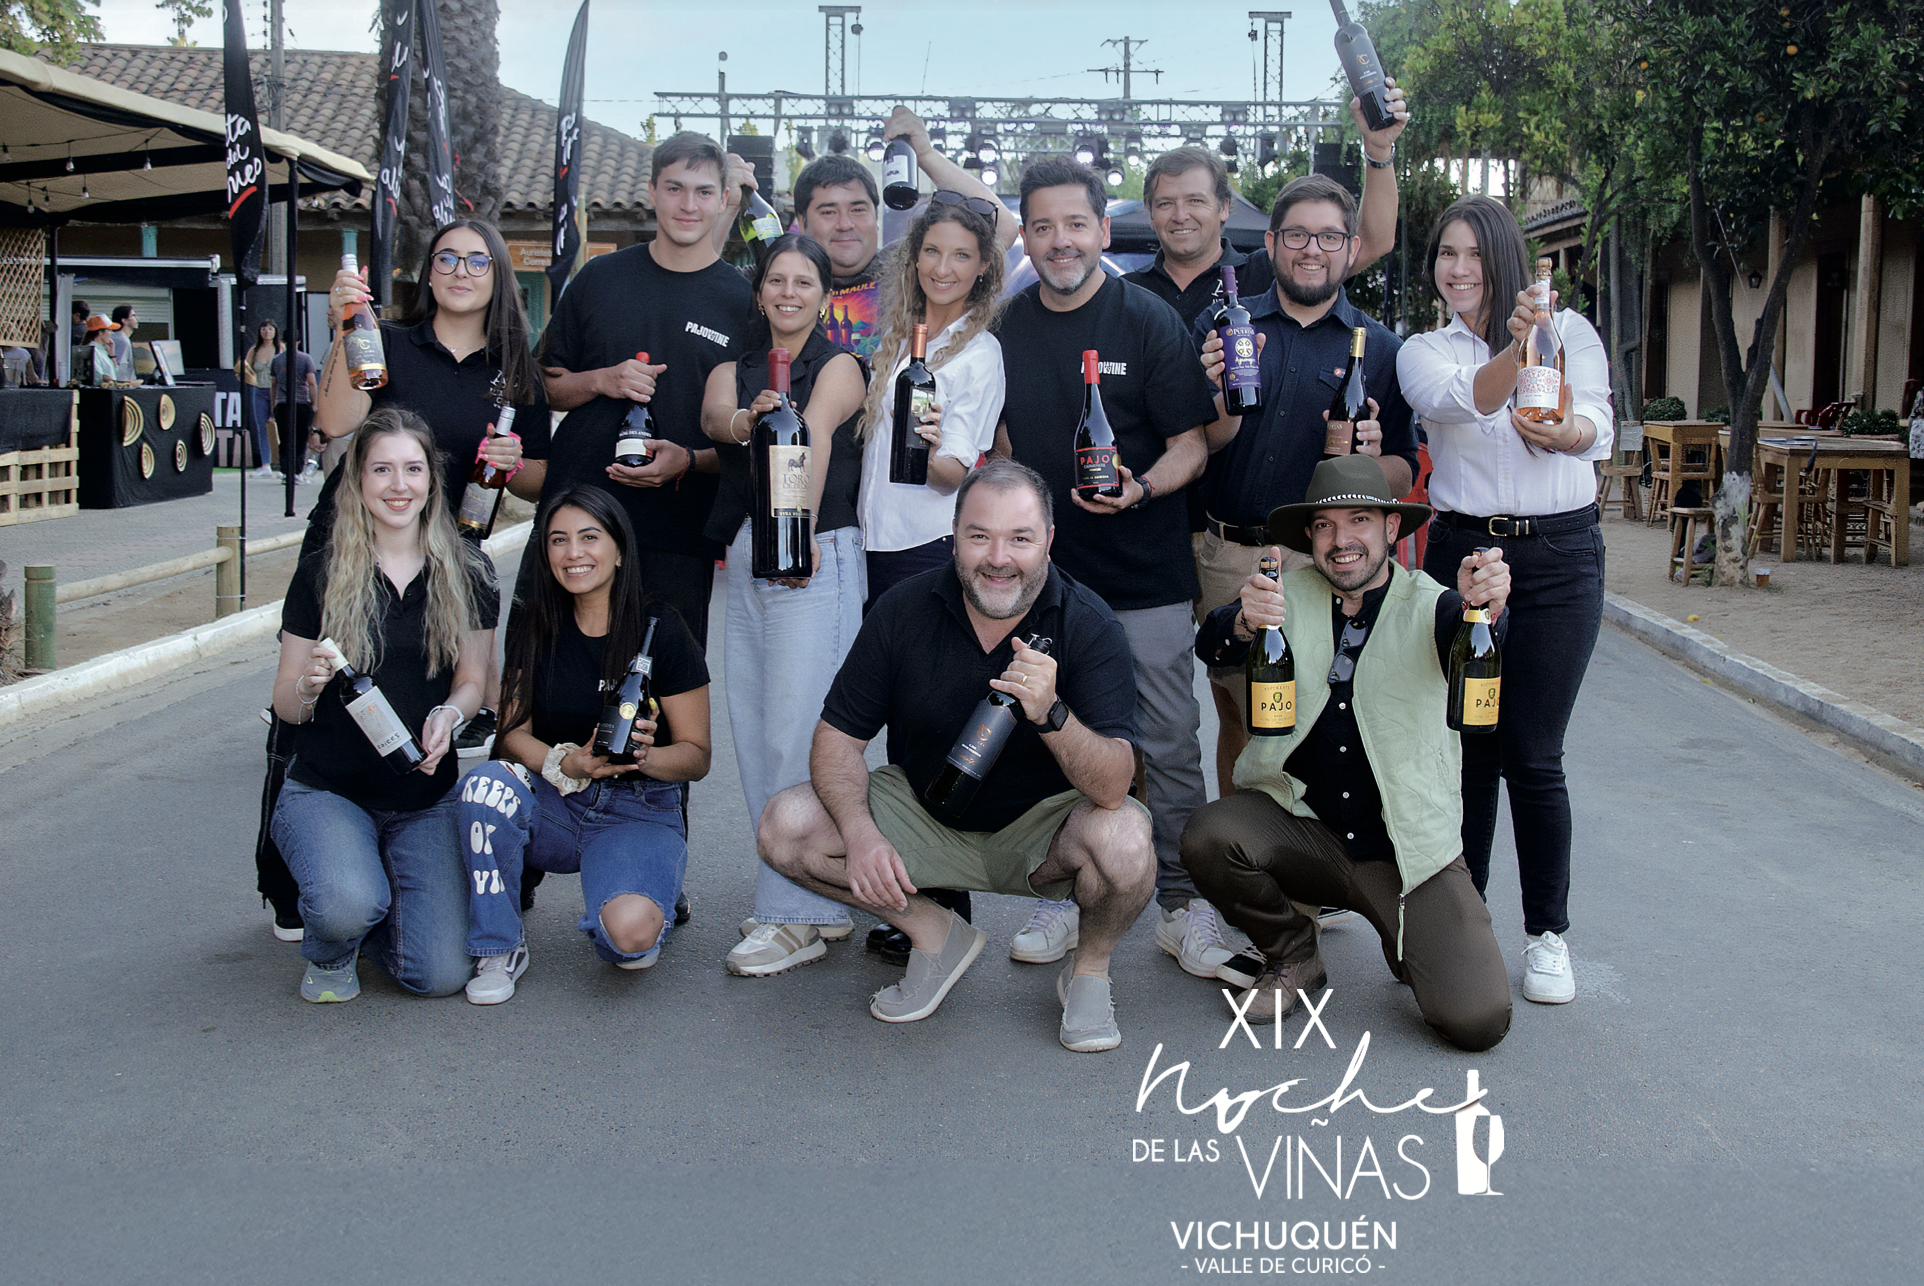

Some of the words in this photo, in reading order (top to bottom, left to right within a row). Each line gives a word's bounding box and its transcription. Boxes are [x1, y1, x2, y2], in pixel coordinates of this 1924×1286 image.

[1080, 454, 1110, 465] PAJO
[1261, 700, 1292, 711] PAJO
[461, 775, 521, 819] KEEPS
